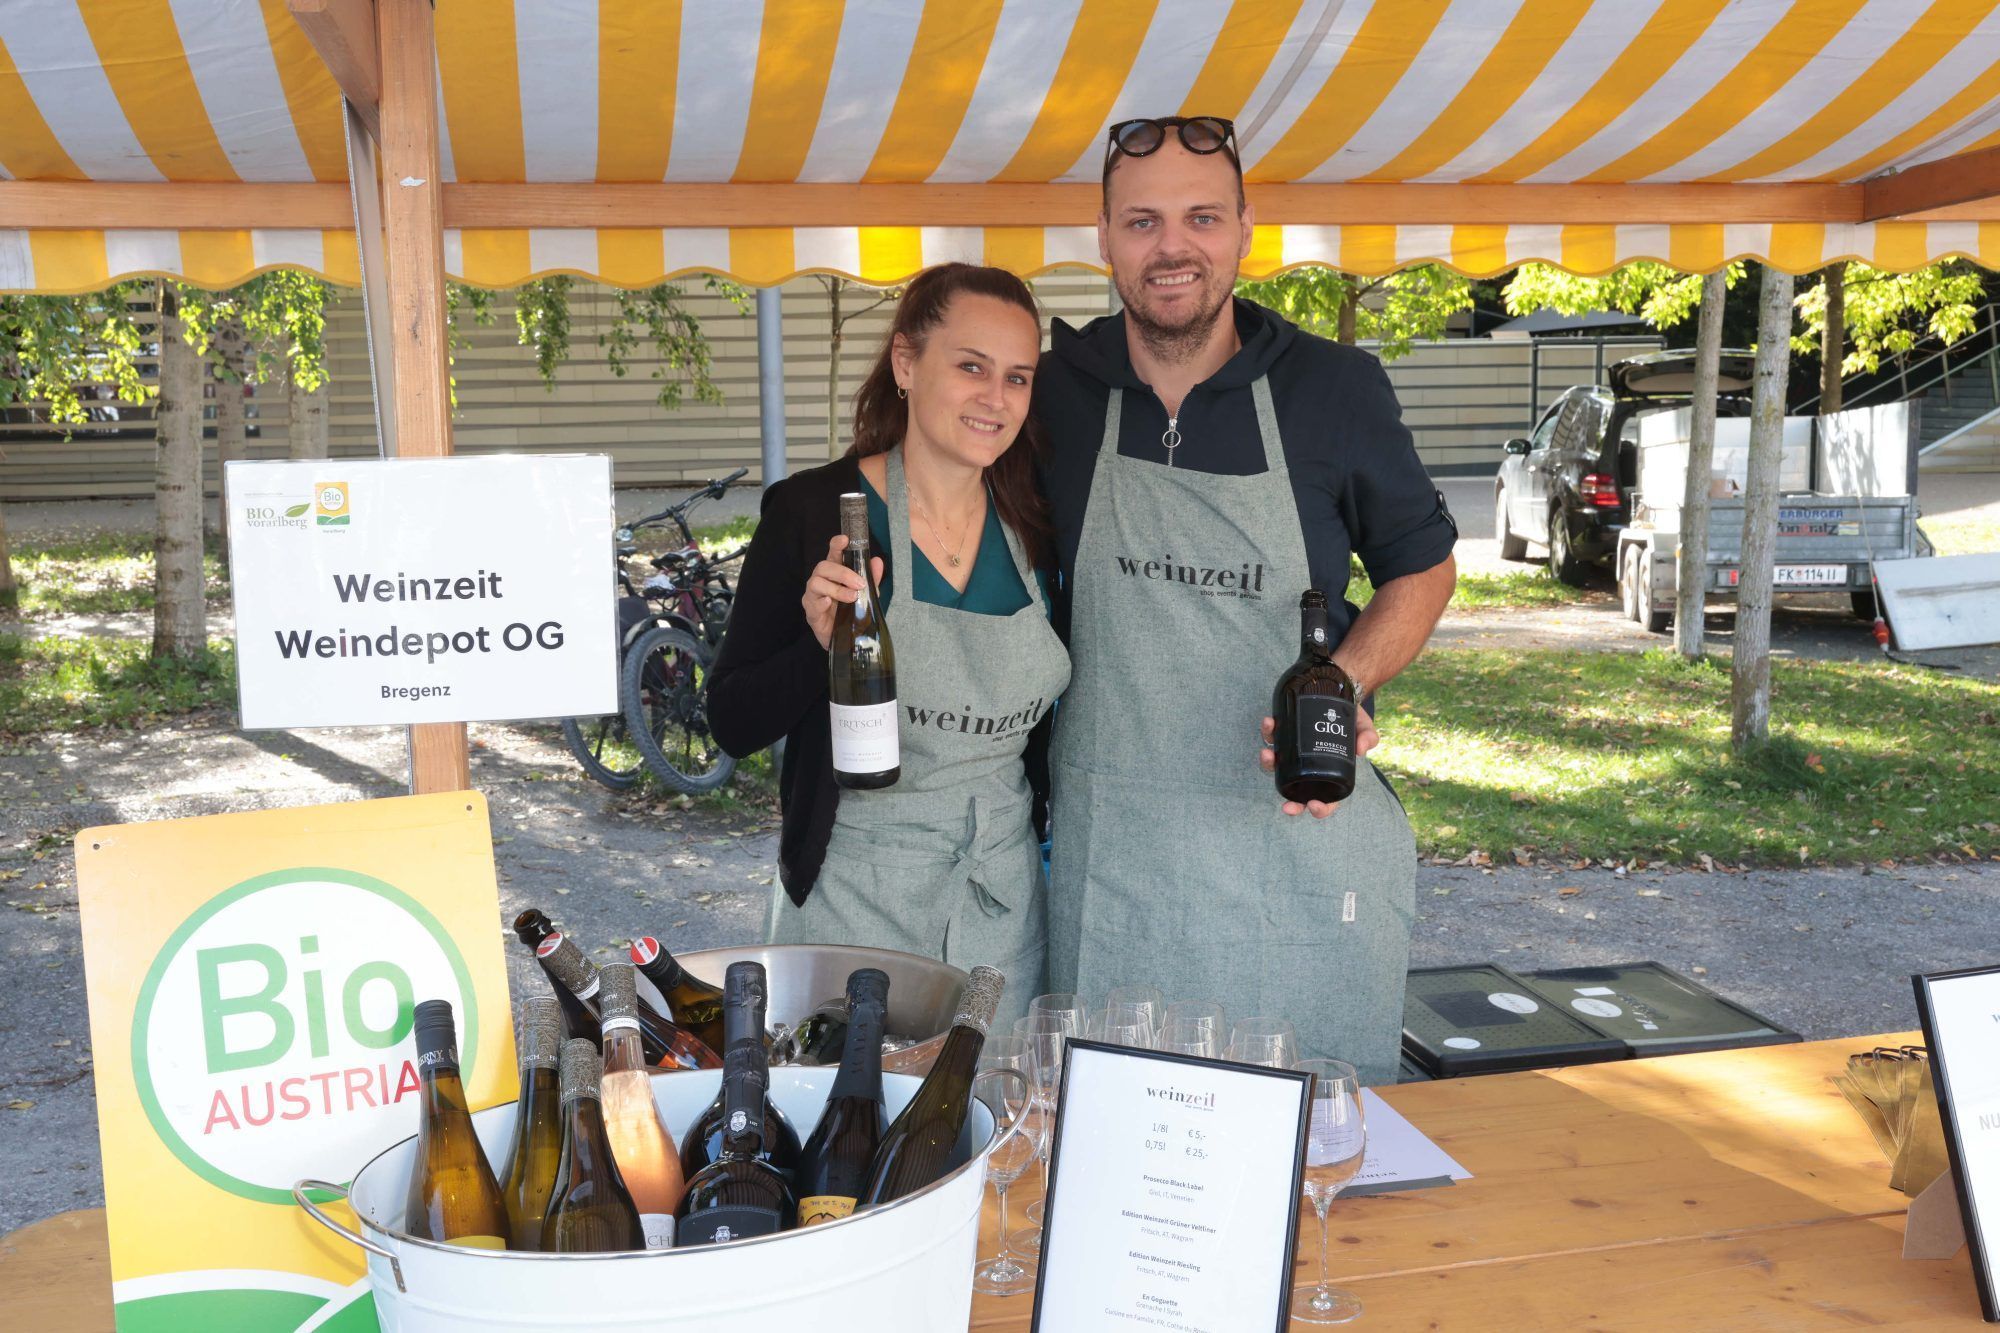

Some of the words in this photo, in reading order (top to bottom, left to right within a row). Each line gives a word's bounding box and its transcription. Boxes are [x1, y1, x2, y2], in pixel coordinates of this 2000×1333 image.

[324, 491, 341, 502] Bio
[246, 507, 275, 519] BIO
[247, 516, 308, 530] vorarlberg
[1115, 554, 1265, 592] weinzeit
[1778, 569, 1794, 581] FK
[1805, 568, 1823, 580] 114
[332, 569, 503, 603] Weinzeit
[275, 626, 491, 664] Weindepot
[502, 621, 564, 652] OG
[381, 685, 451, 701] Bregenz
[905, 697, 1043, 735] weinzeit
[839, 719, 883, 733] FRITSCH
[1314, 721, 1347, 737] GIOL
[197, 934, 415, 1074] Bio
[204, 1060, 421, 1135] AUSTRIA
[1143, 1174, 1169, 1185] Prosecco
[1170, 1179, 1186, 1188] Black
[1187, 1183, 1204, 1191] Label
[1121, 1209, 1143, 1219] Edition
[1143, 1214, 1169, 1224] Weinzeit
[1169, 1219, 1190, 1229] Grüner
[1191, 1223, 1216, 1234] Veltliner
[1128, 1251, 1149, 1261] Edition
[1150, 1255, 1176, 1266] Weinzeit
[1176, 1260, 1201, 1272] Riesling
[1142, 1293, 1150, 1301] En
